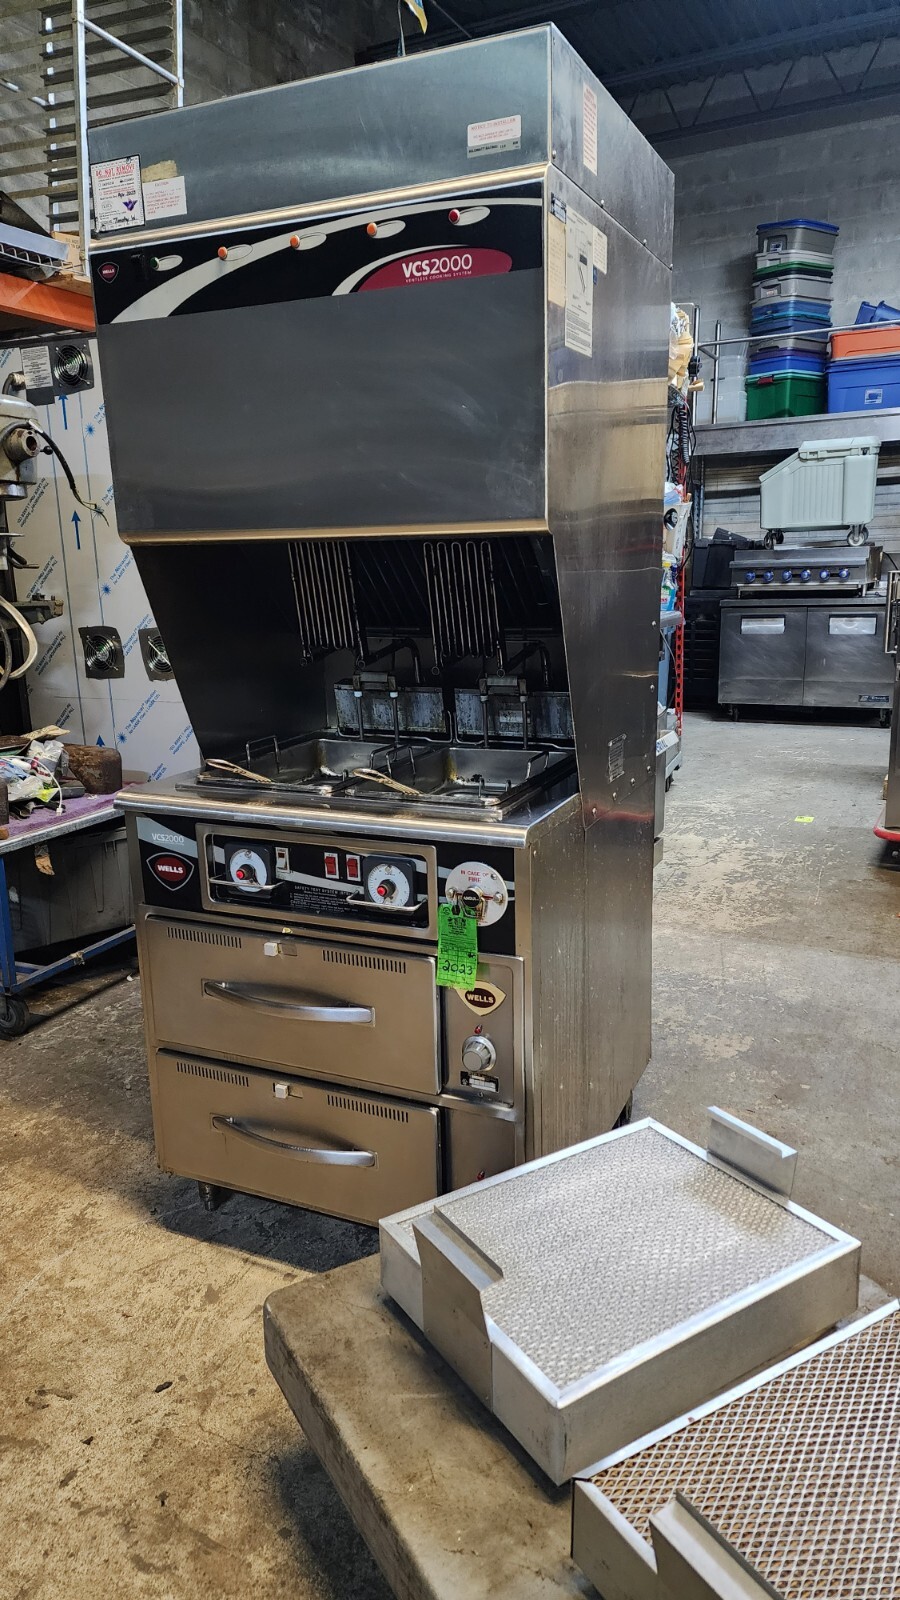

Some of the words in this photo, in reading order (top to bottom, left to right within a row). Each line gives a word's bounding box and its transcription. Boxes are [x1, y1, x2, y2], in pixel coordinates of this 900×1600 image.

[402, 254, 472, 278] VCS2000
[152, 833, 184, 843] VCS2000
[157, 864, 184, 874] WELLS
[442, 960, 473, 975] 2023
[466, 993, 494, 1003] WELLS
